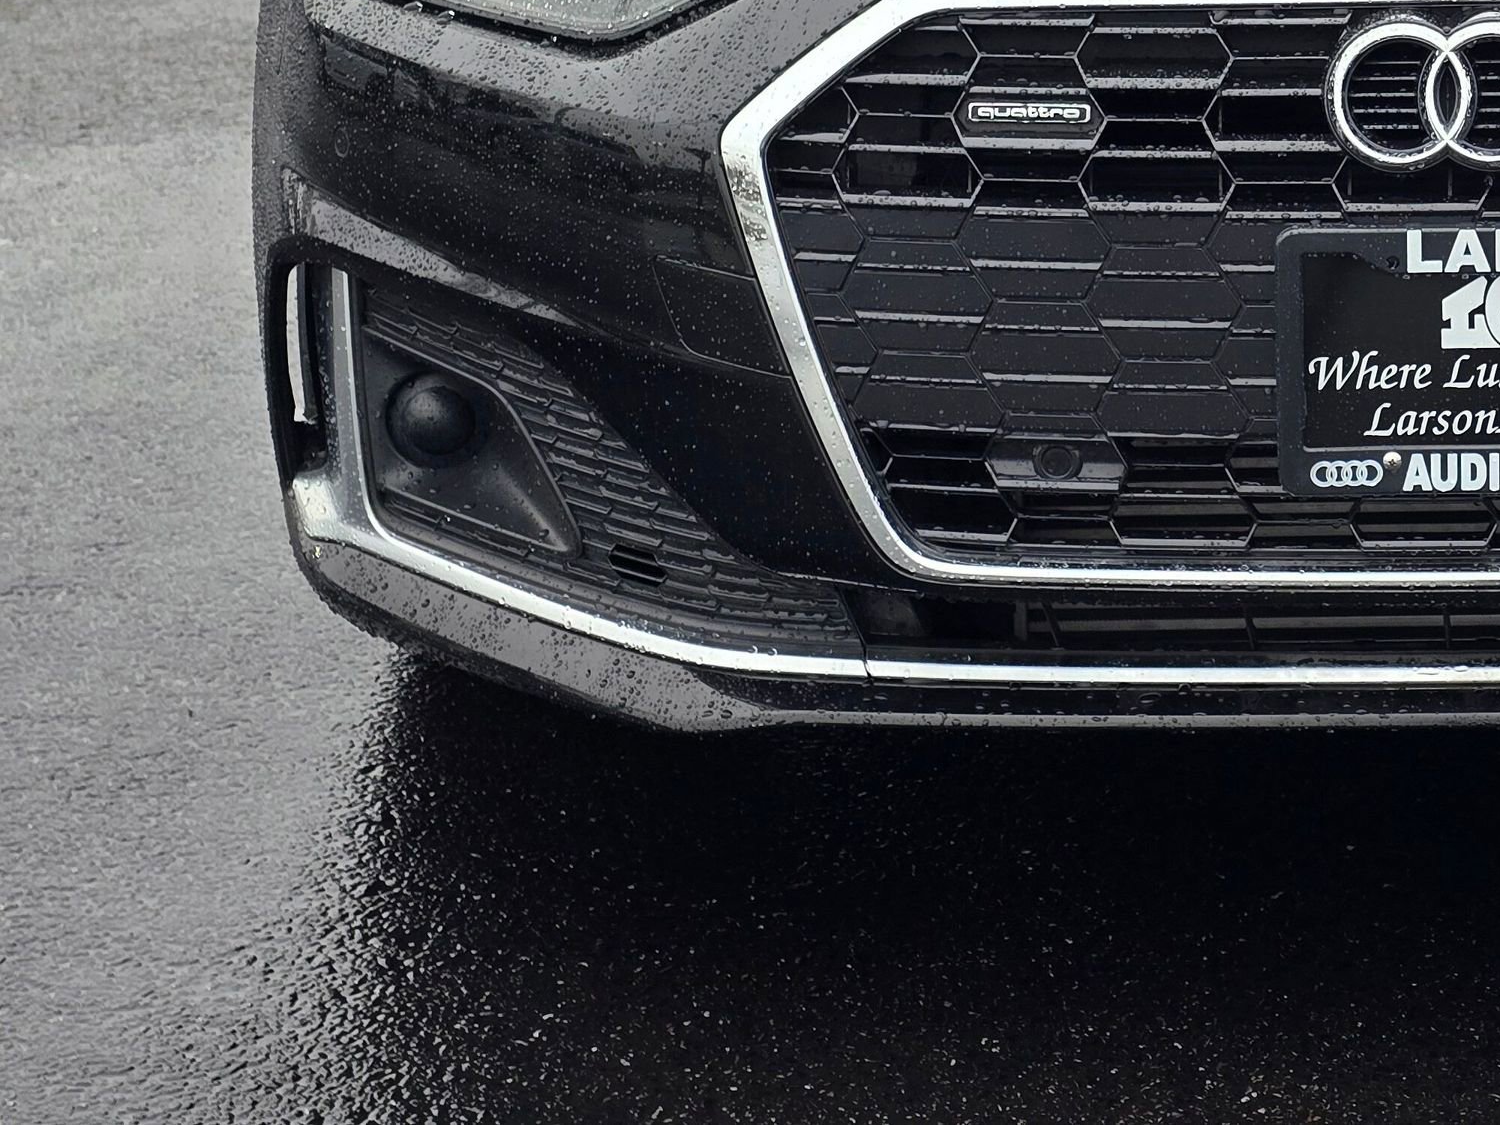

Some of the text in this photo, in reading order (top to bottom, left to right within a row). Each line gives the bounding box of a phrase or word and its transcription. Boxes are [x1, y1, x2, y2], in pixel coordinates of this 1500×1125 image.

[977, 106, 1080, 119] quattro
[1308, 351, 1432, 392] Where
[1403, 452, 1500, 491] AUDI
